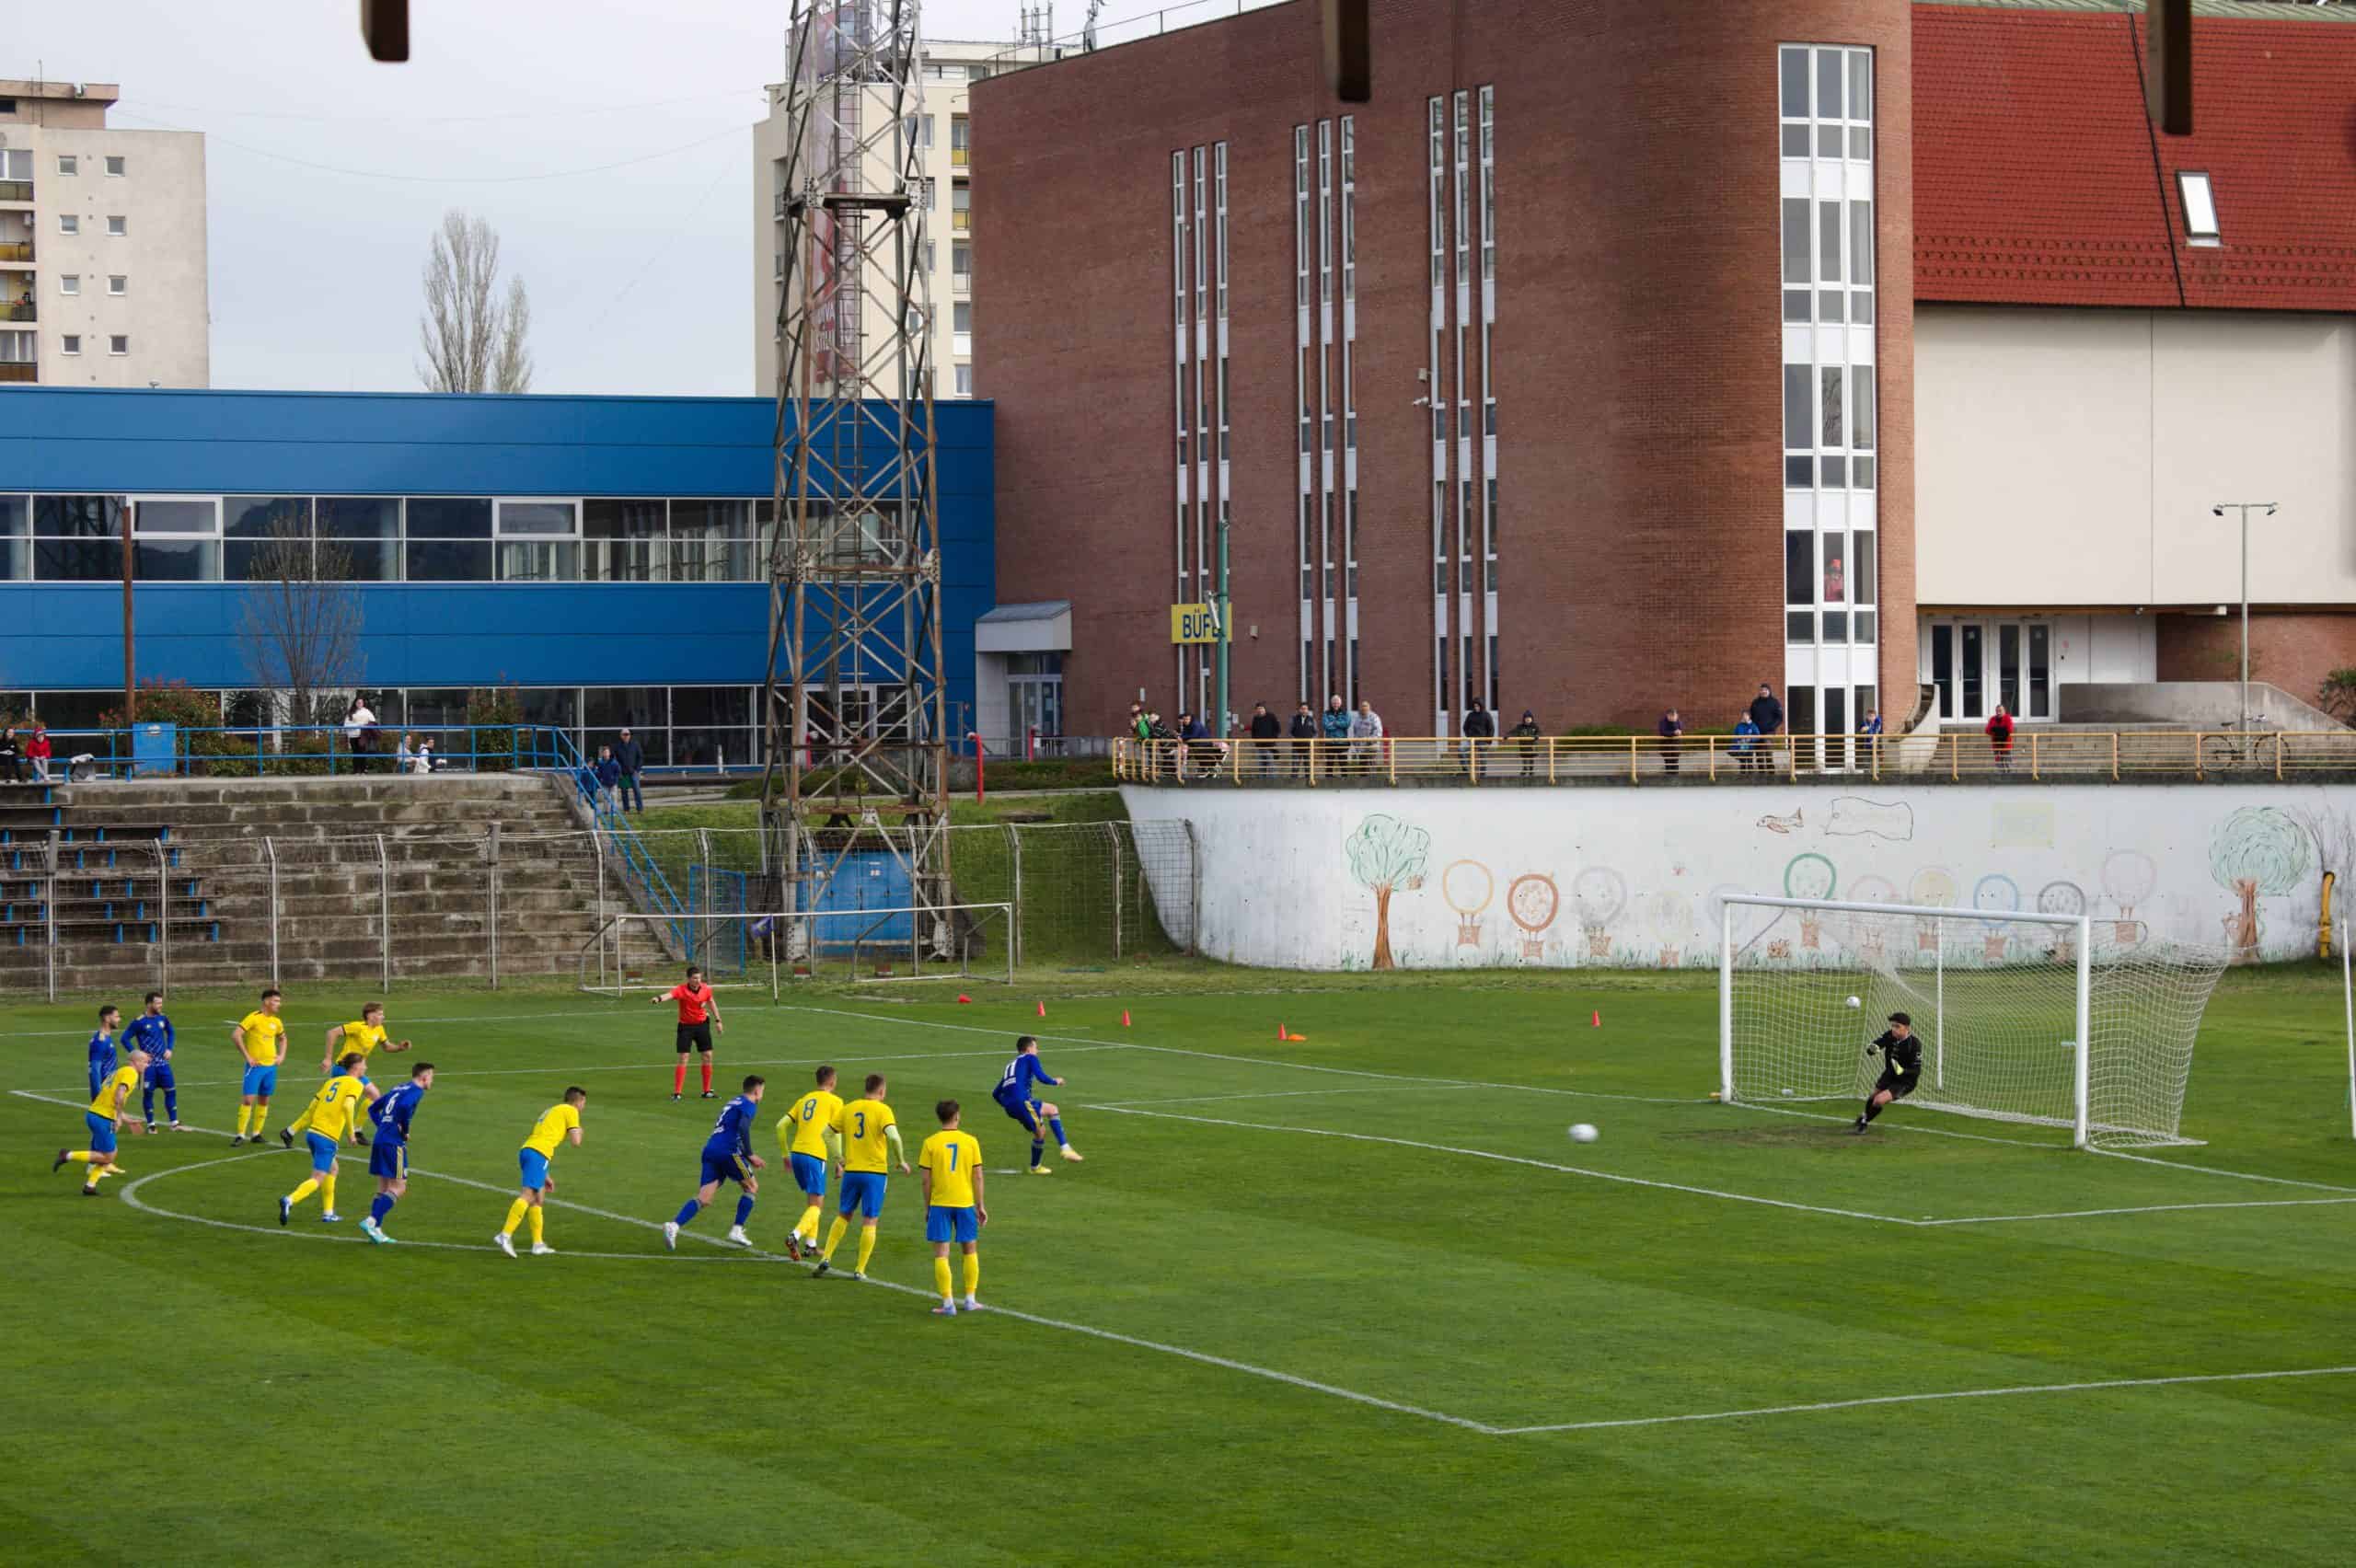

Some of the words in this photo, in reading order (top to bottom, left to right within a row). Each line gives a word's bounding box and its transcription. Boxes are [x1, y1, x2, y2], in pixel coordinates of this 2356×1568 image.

[1004, 1059, 1018, 1079] 11
[325, 1081, 341, 1102] 5
[386, 1091, 400, 1115] 6
[803, 1098, 817, 1122] 8
[853, 1112, 865, 1139] 3
[945, 1143, 959, 1172] 7
